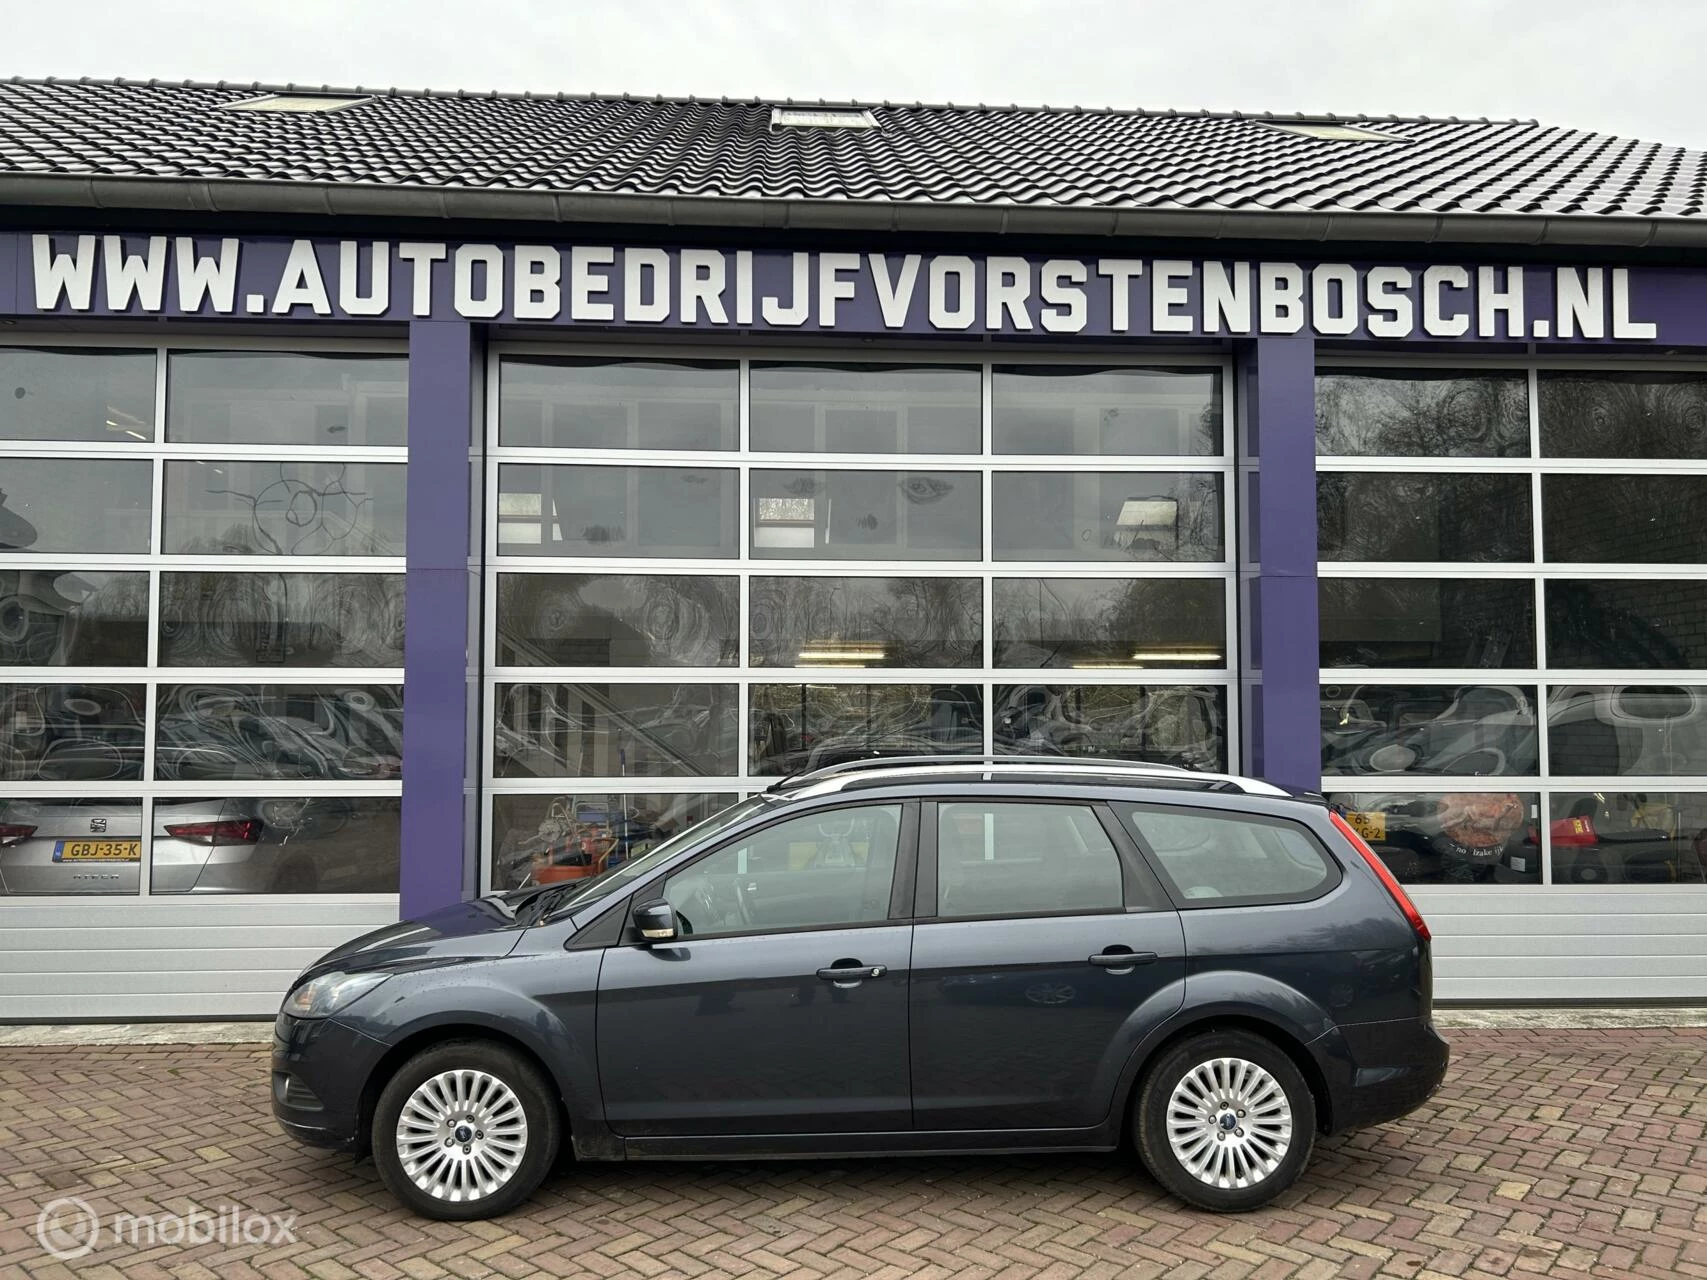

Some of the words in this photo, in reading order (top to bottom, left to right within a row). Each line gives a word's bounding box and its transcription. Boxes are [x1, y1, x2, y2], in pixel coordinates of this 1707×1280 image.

[32, 234, 1657, 340] WWW.AUTOBEDRIJFVORSTENBOSCH.NL
[1354, 827, 1381, 839] G-2
[70, 843, 138, 856] GBJ-35-K
